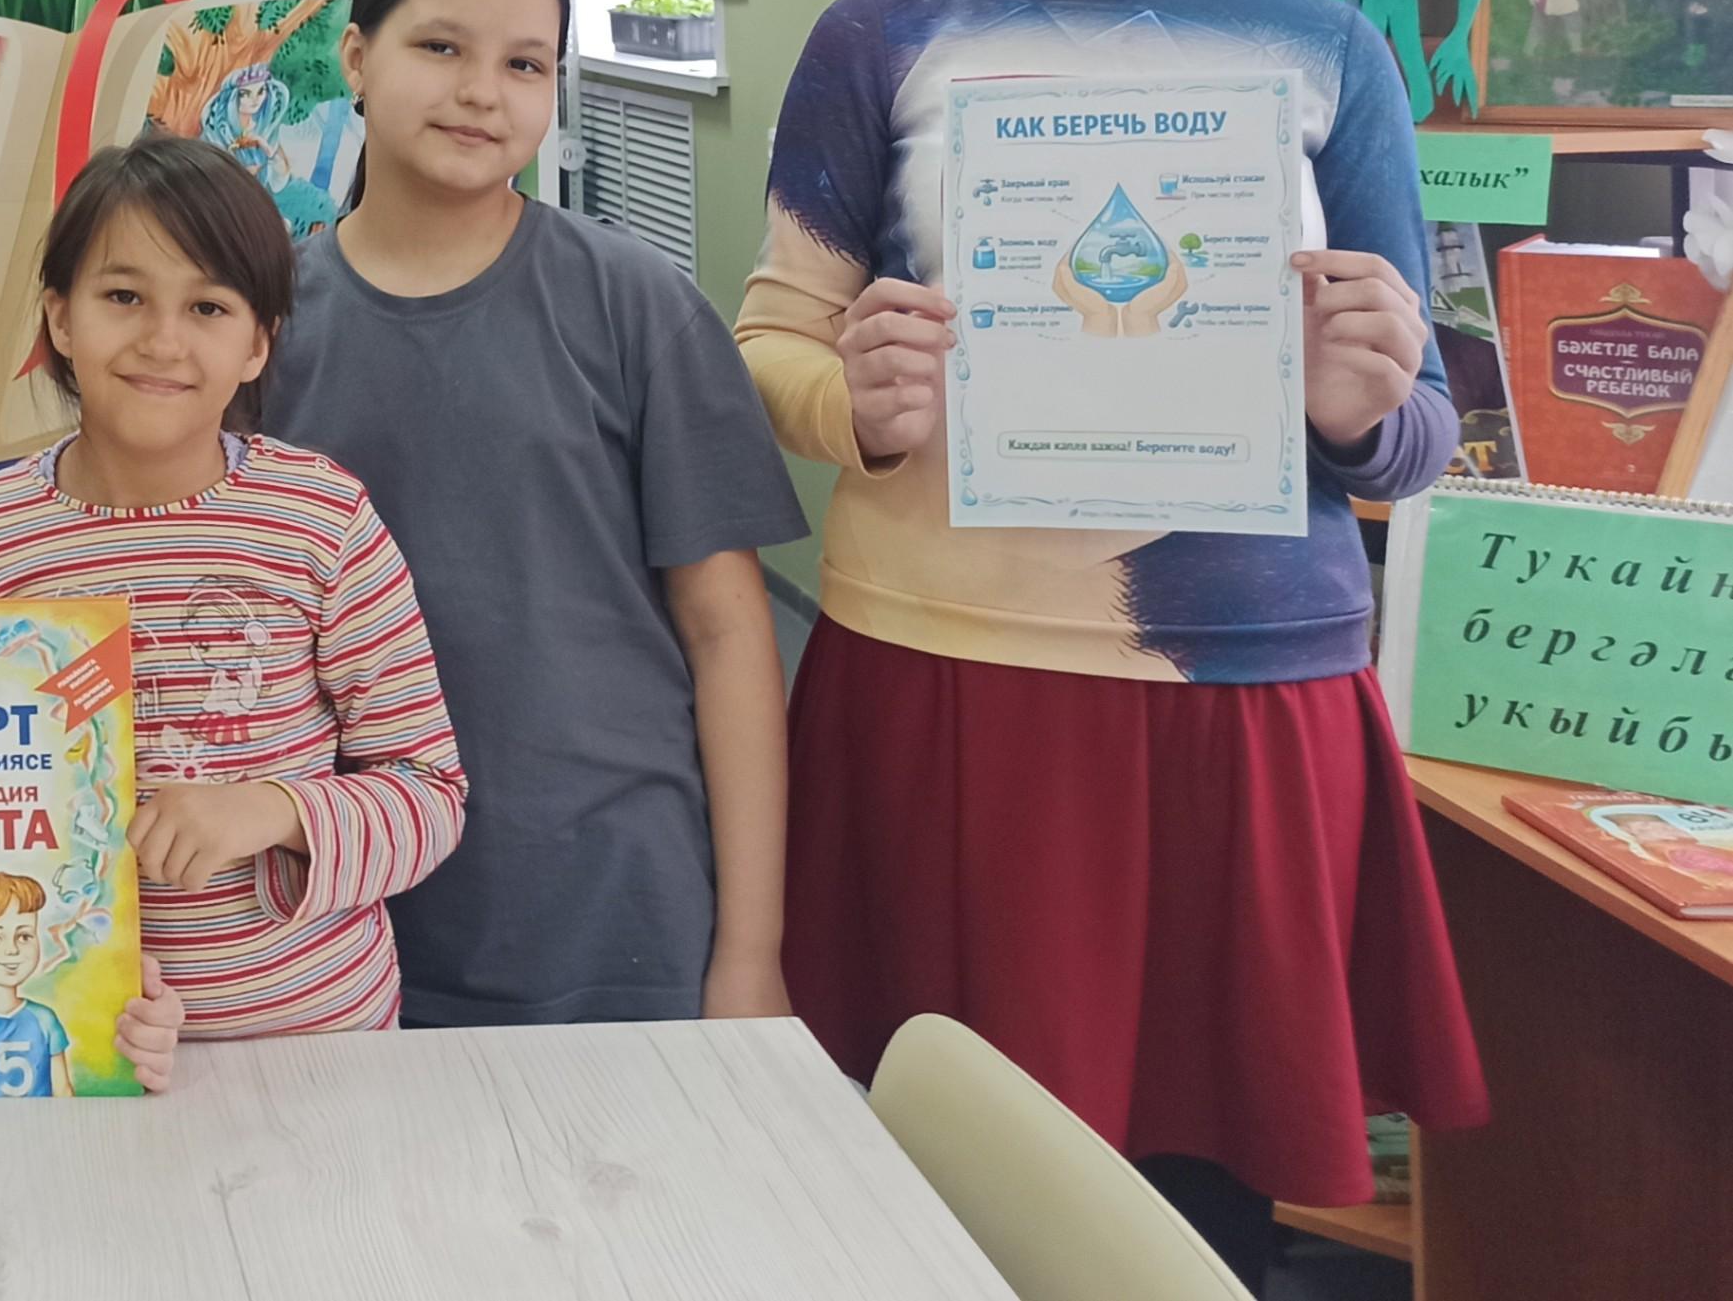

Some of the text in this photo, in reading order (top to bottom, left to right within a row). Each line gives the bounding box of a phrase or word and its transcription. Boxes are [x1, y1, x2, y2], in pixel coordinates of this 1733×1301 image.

[996, 110, 1227, 139] КАК БЕРЕЧЬ ВОДУ
[1556, 339, 1700, 361] БӘХЕТЛЕ БАЛА
[1563, 363, 1694, 385] СЧАСТЛИВЫЙ
[1585, 381, 1672, 399] РЕБЕНОК
[1007, 438, 1236, 457] Каждая капля важна! Берегите воду!
[1462, 607, 1733, 682] бергәл
